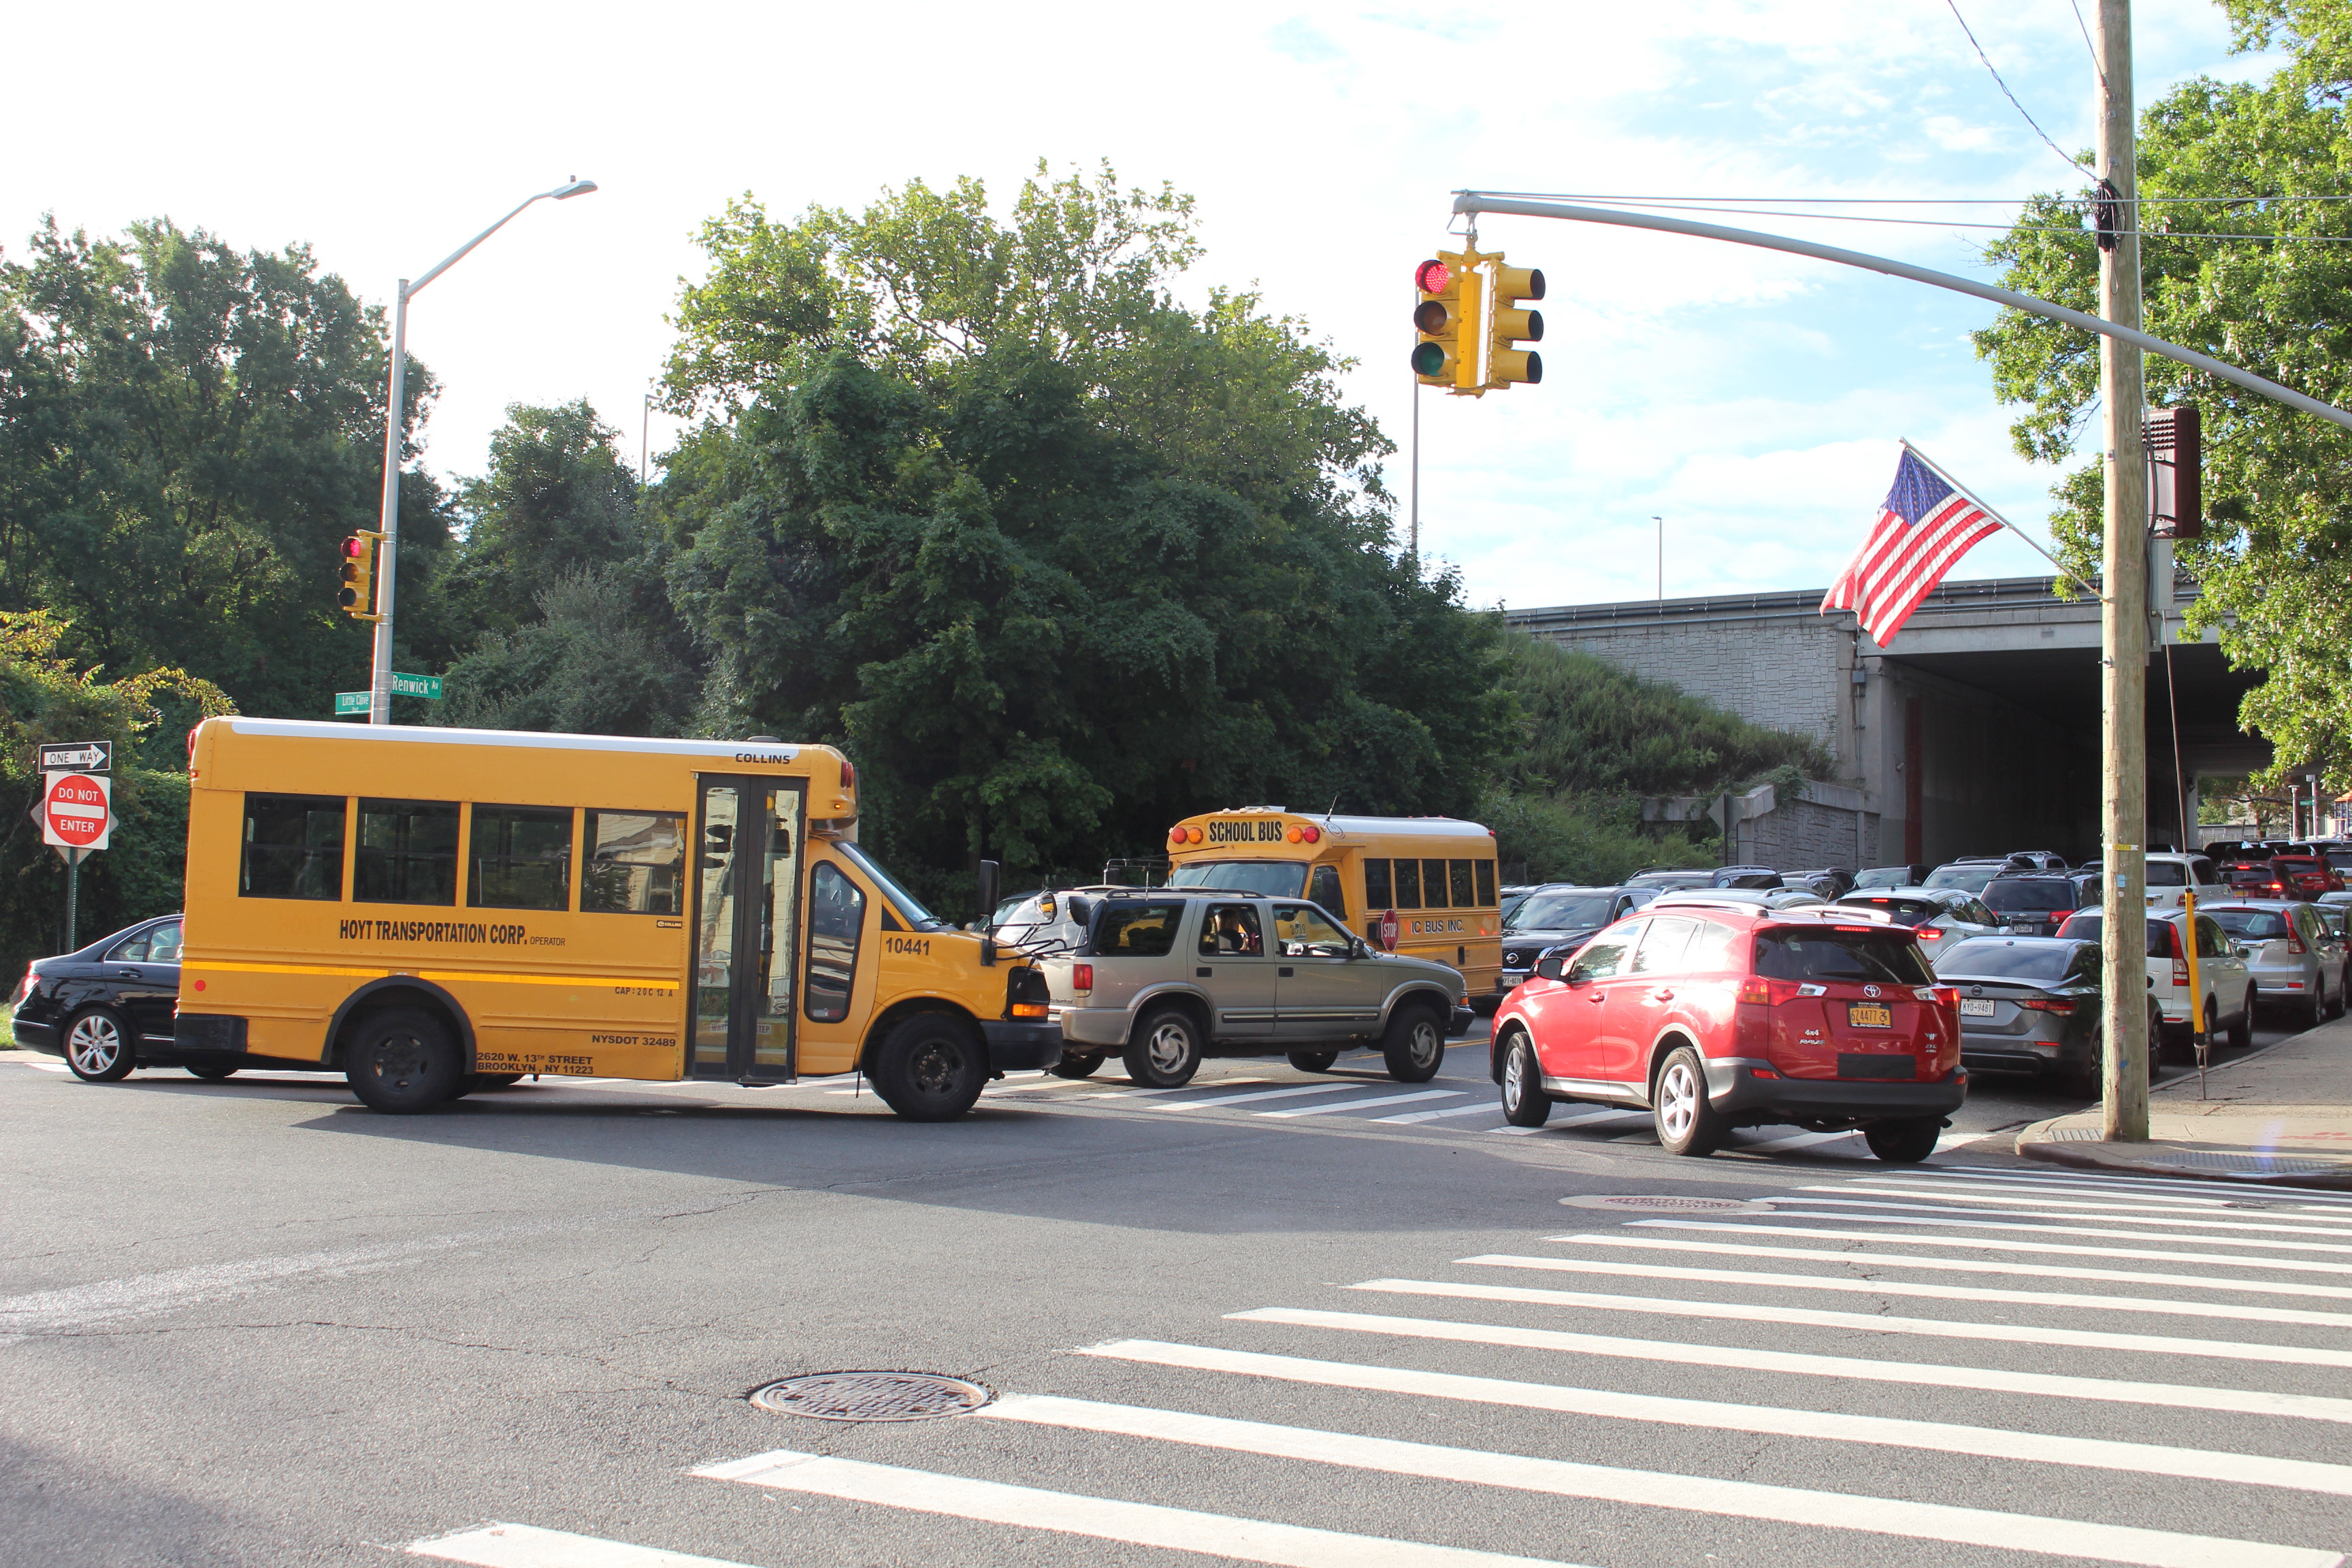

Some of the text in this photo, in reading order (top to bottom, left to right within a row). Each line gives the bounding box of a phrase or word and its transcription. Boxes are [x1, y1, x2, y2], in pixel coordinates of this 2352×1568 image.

[392, 674, 439, 695] Renwick Av
[342, 695, 355, 706] Little
[50, 751, 100, 764] ONE WAY
[736, 753, 790, 764] COLLINS
[59, 787, 99, 802] DO NOT
[60, 819, 95, 833] ENTER
[1209, 821, 1282, 842] SCHOOL BUS
[340, 919, 374, 940] HOYT
[376, 920, 487, 943] TRANSPORTATION
[490, 924, 527, 945] CORP.
[530, 936, 566, 946] OPERATOR
[1384, 922, 1397, 938] STOP
[1424, 920, 1443, 934] BUS
[1447, 919, 1465, 933] INC.
[886, 937, 930, 956] 10441
[1851, 1009, 1877, 1022] 624477
[592, 1034, 676, 1047] NYSDOT 32489
[476, 1052, 504, 1061] 2620
[508, 1054, 520, 1062] W.
[549, 1055, 593, 1065] STREET
[563, 1065, 593, 1075] 11223
